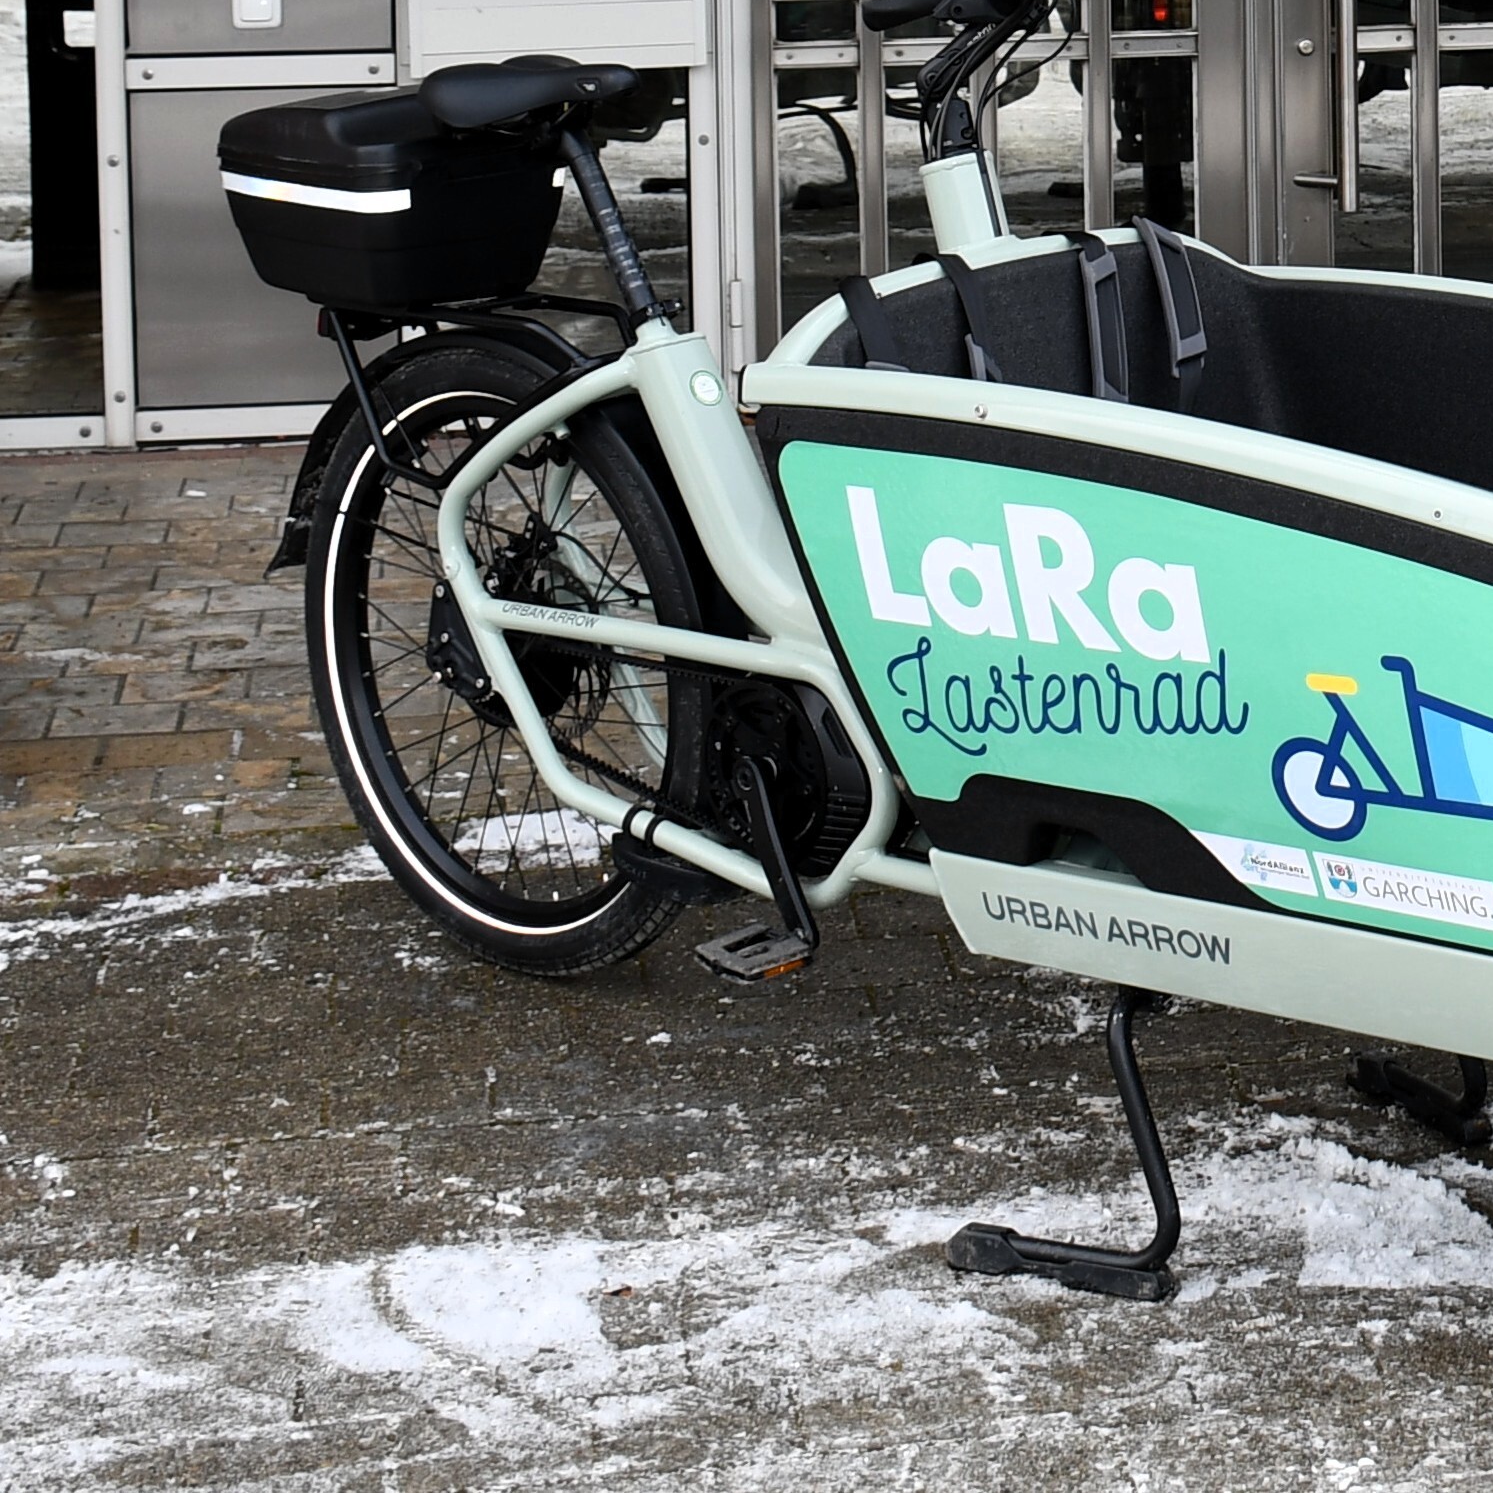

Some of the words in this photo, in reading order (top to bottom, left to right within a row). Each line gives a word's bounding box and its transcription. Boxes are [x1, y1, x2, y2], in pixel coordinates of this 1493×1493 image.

[501, 602, 547, 621] URBAN
[547, 610, 600, 629] ARROW
[845, 484, 1212, 664] LaRa
[887, 635, 1250, 757] Lastenrad
[981, 891, 1100, 940] URBAN
[1107, 915, 1231, 965] ARROW
